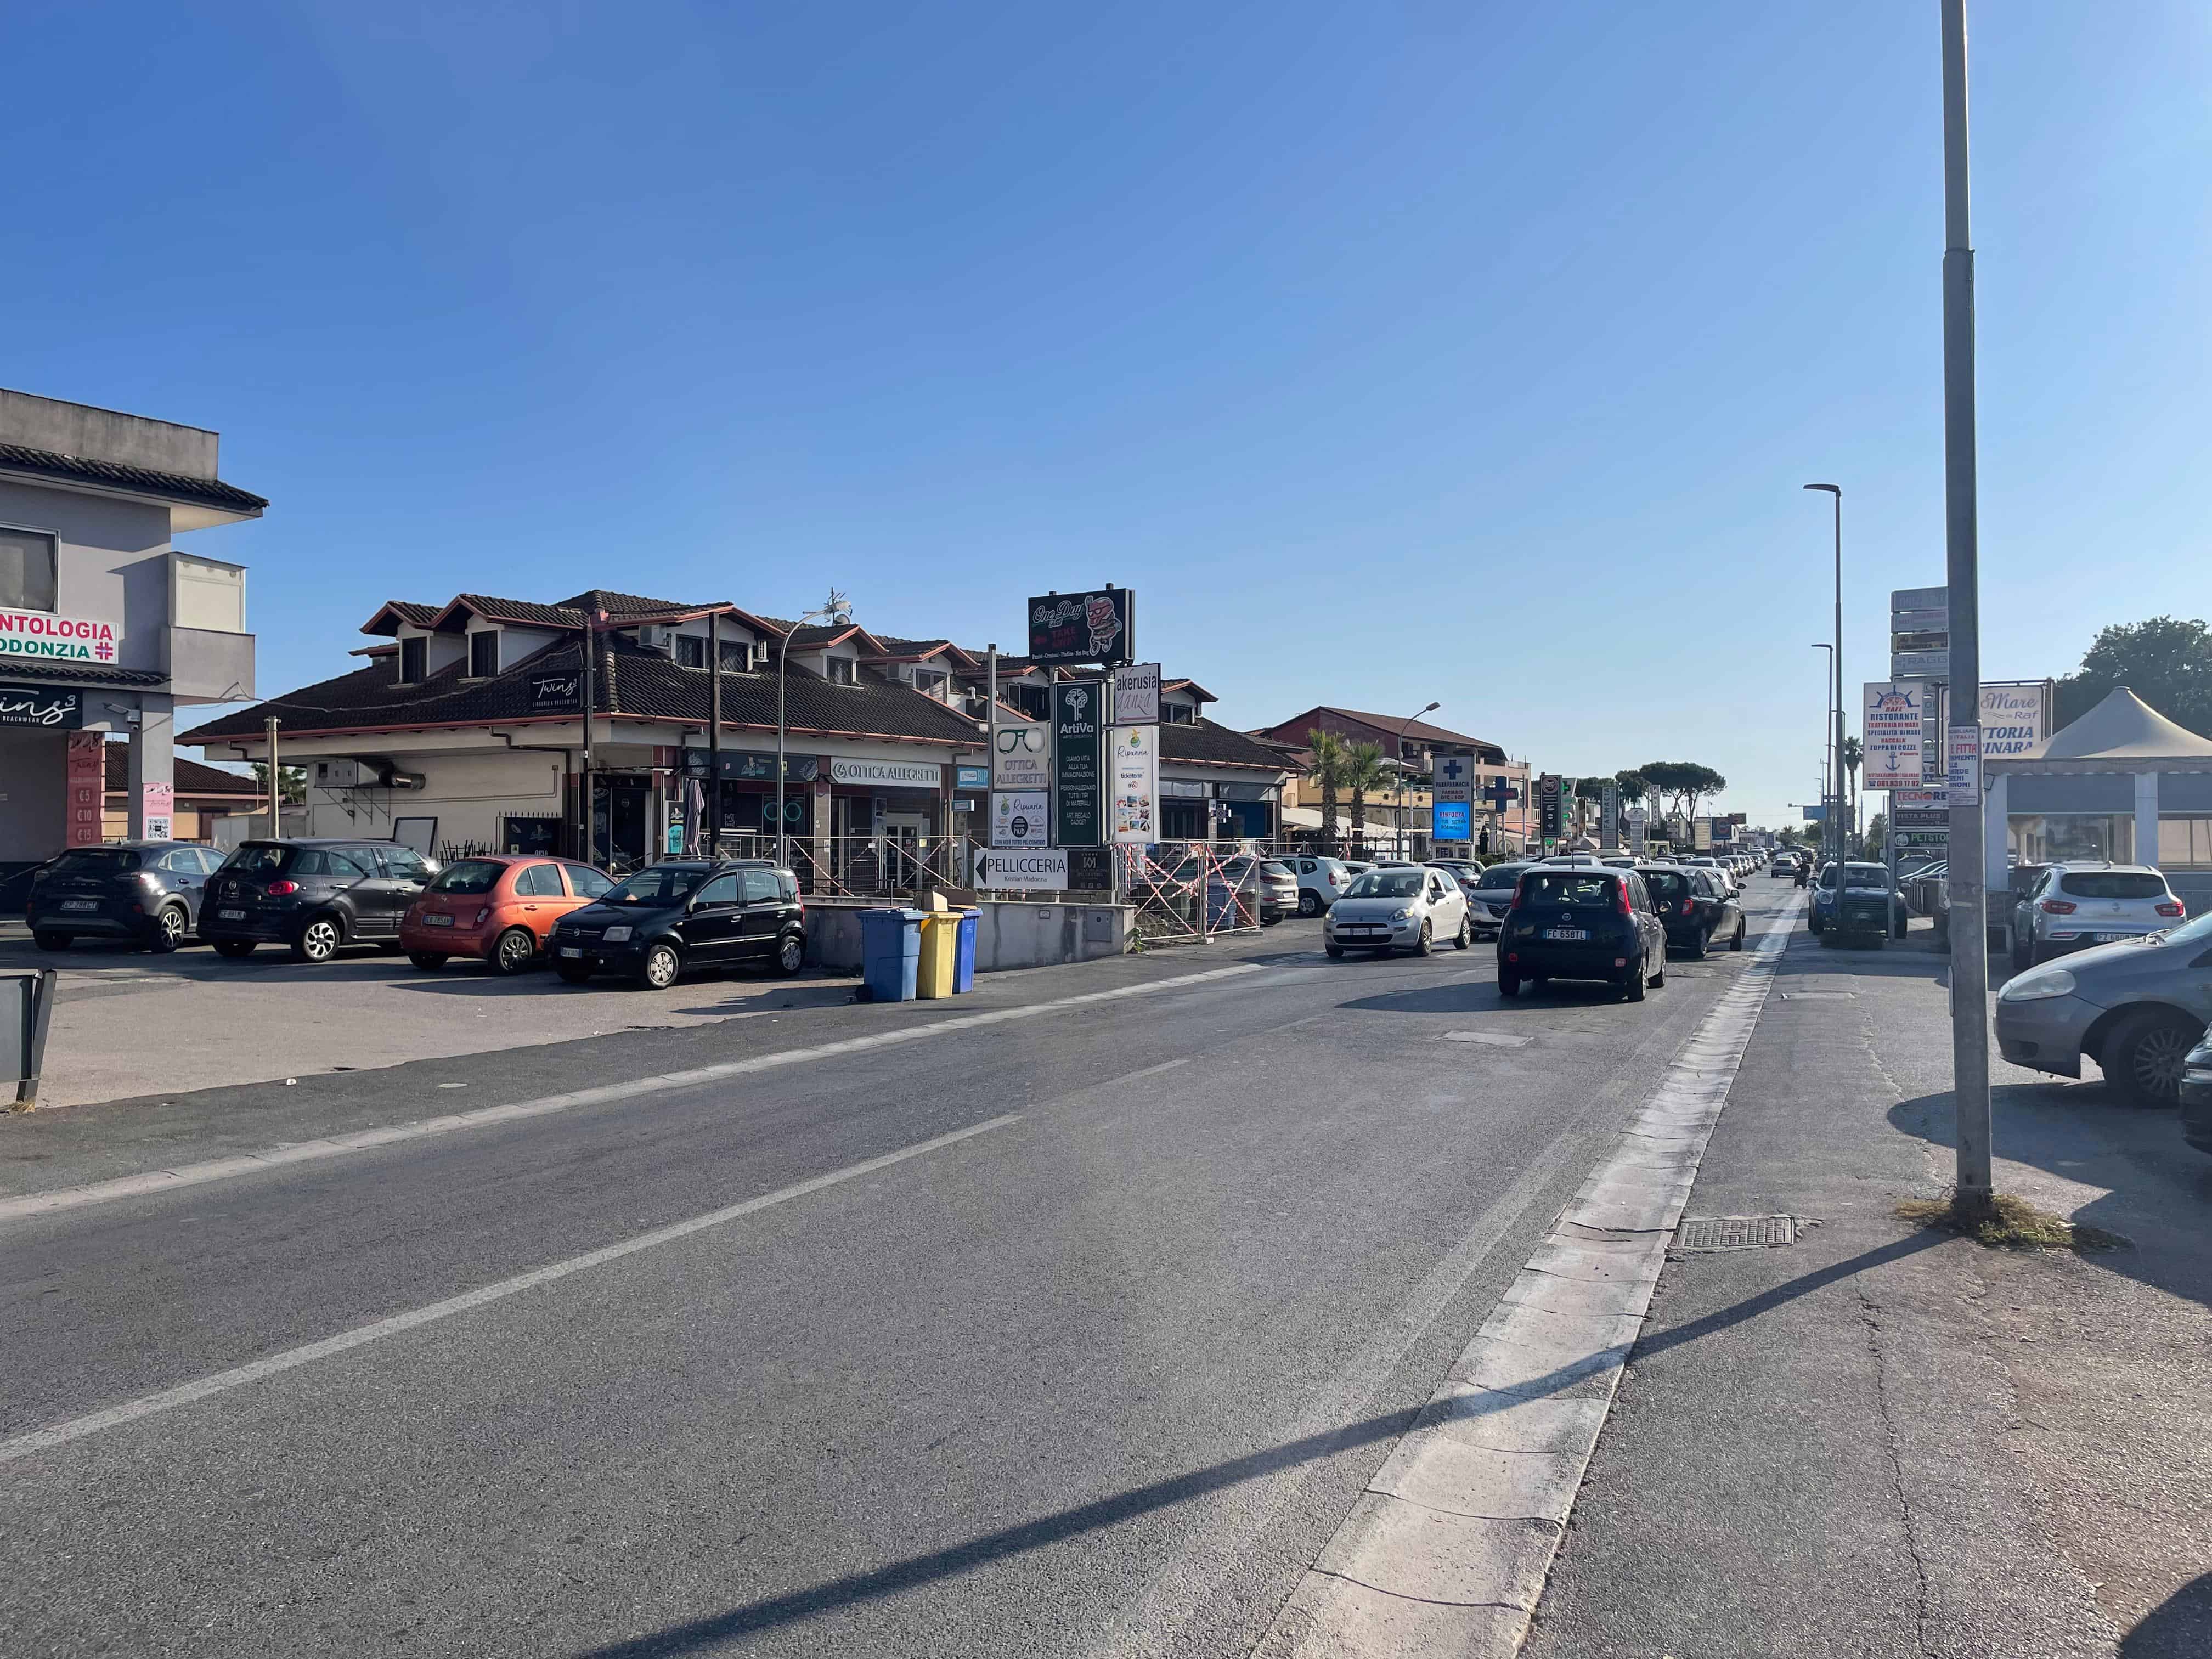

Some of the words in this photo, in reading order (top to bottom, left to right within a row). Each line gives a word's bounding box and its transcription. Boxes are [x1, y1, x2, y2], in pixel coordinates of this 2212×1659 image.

[1032, 605, 1056, 623] One
[1055, 600, 1085, 620] Day
[0, 614, 114, 641] NTOLOGIA
[1117, 672, 1156, 691] akerusia
[2, 715, 40, 724] BEACHWEAR
[1060, 722, 1094, 733] ArtiVa
[1005, 760, 1037, 770] OTTICA
[850, 764, 887, 778] OTTICA
[888, 767, 940, 782] ALLEGRETTI
[996, 772, 1047, 784] ALLEGRETTI
[1897, 792, 1949, 800] TECNORE
[1603, 788, 1611, 829] FARMACIA
[988, 858, 1066, 874] PELLICCERIA
[1548, 930, 1558, 938] FC
[1560, 930, 1585, 939] 638TL
